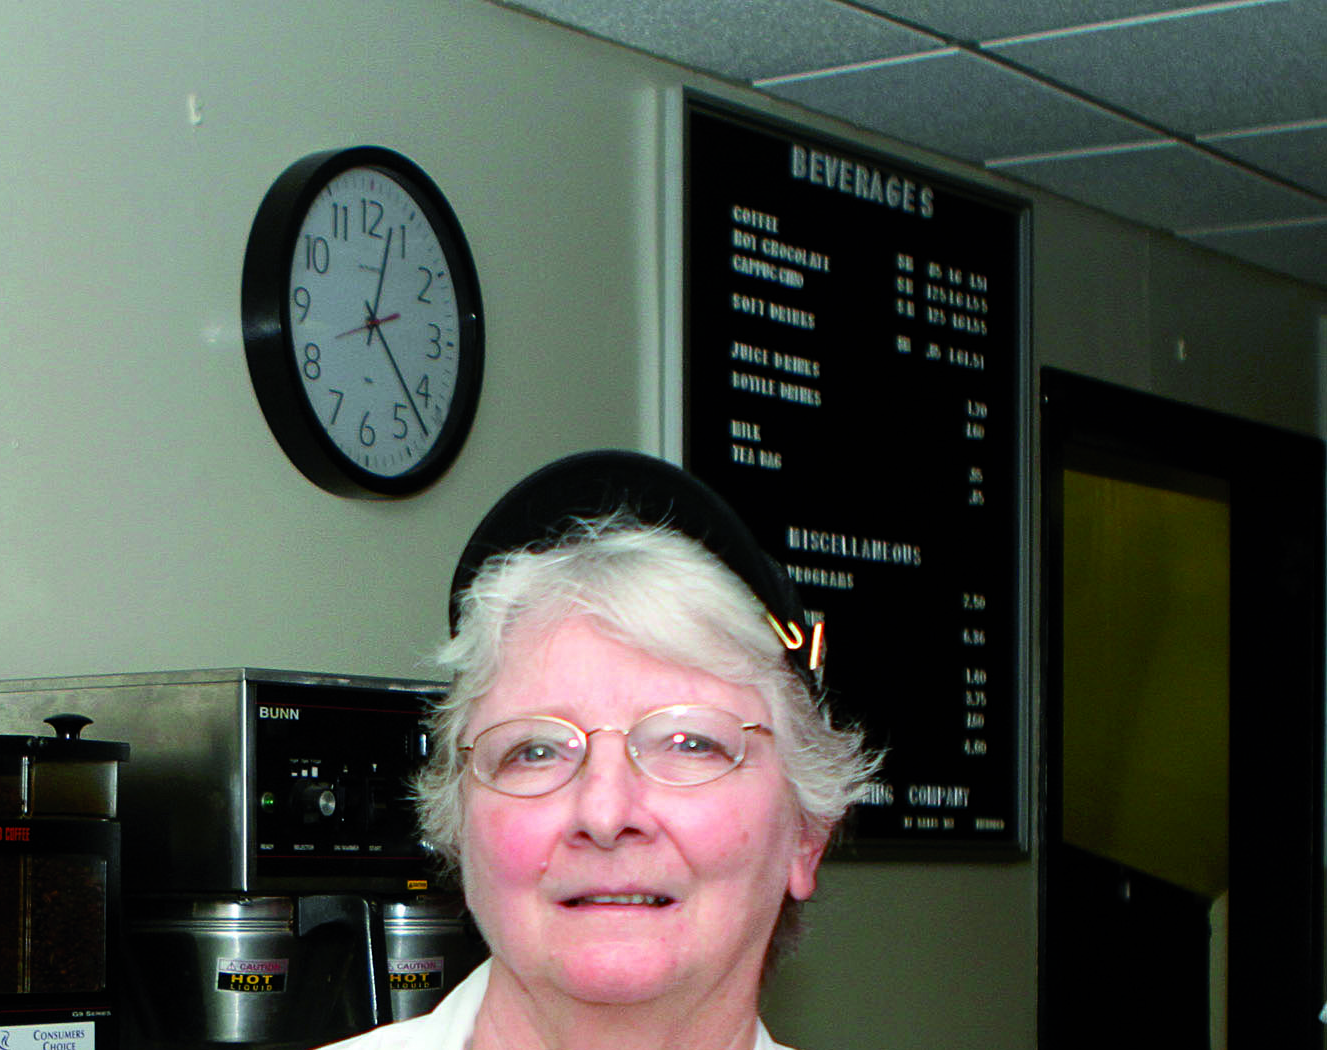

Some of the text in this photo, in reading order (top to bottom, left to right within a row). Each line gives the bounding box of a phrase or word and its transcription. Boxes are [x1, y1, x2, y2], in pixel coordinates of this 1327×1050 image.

[791, 144, 934, 218] BEVERAGES
[332, 203, 348, 241] 11
[361, 198, 385, 239] 12
[731, 204, 780, 235] COFFEE
[305, 234, 329, 274] 10
[400, 224, 406, 259] 1
[418, 267, 433, 304] 2
[293, 287, 311, 323] 9
[426, 323, 442, 360] 3
[304, 343, 321, 380] 8
[731, 340, 821, 379] JUICE DRINKS
[328, 389, 344, 425] 7
[416, 374, 430, 409] 4
[779, 382, 823, 408] DRINKS
[359, 411, 375, 446] 6
[393, 402, 408, 439] 5
[731, 419, 762, 442] MILK
[731, 443, 756, 466] TEA
[787, 525, 923, 568] MISCELLANEOUS
[259, 706, 300, 721] BUNN
[908, 784, 970, 807] COMPANY
[5, 827, 30, 841] COFFEE
[231, 975, 273, 985] HOT
[390, 973, 428, 983] HOT
[397, 962, 436, 971] CAUTION
[230, 984, 274, 992] LIQUID
[33, 1030, 85, 1041] CONSUMERS
